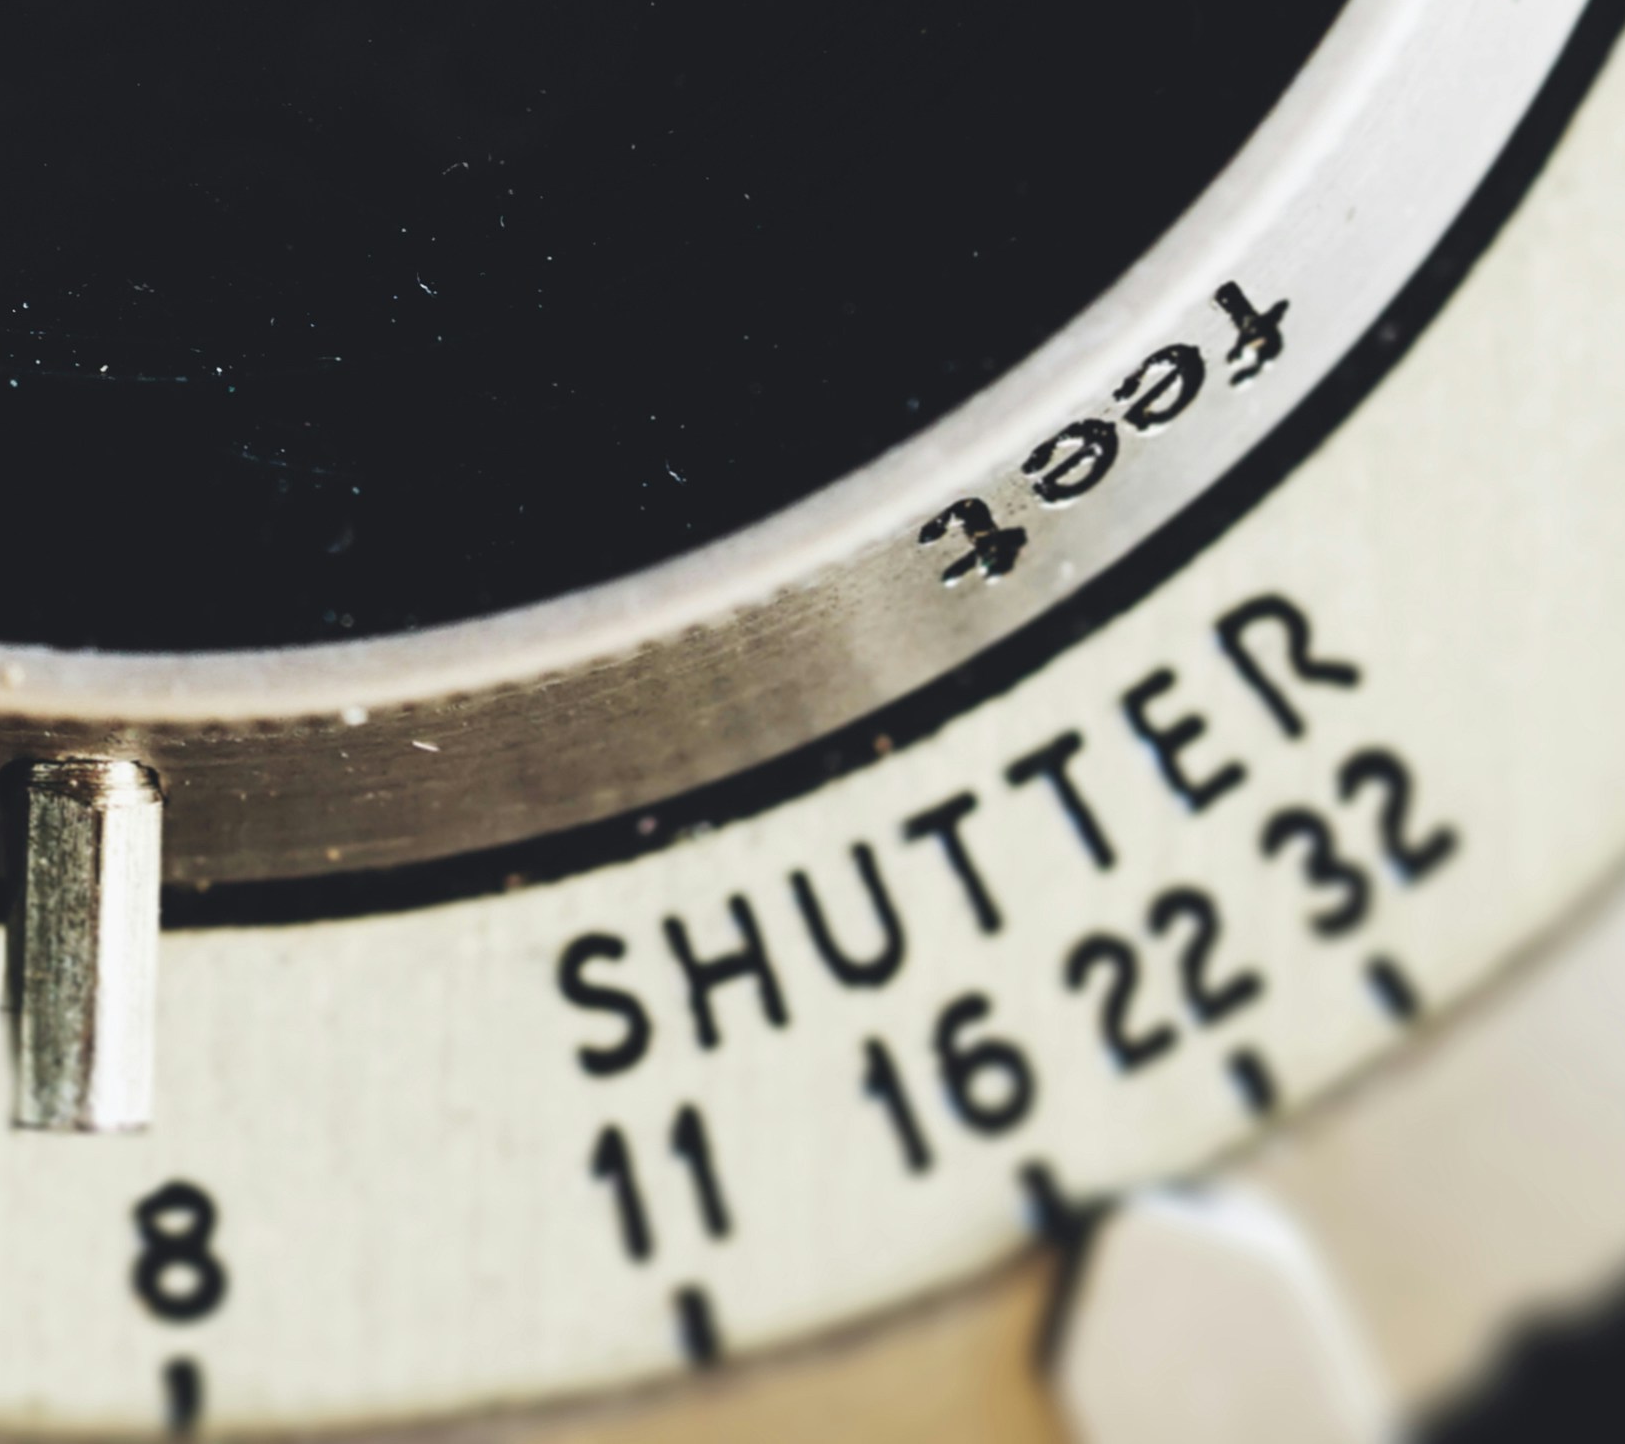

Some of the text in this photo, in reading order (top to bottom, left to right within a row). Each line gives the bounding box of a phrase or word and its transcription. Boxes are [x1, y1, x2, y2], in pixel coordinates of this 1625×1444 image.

[919, 279, 1290, 586] feet
[557, 592, 1363, 1077] SHUTTER
[1258, 746, 1460, 941] 32
[1061, 885, 1264, 1074] 22
[858, 992, 1039, 1177] 16
[128, 1180, 229, 1325] 8
[592, 1104, 733, 1264] 11
